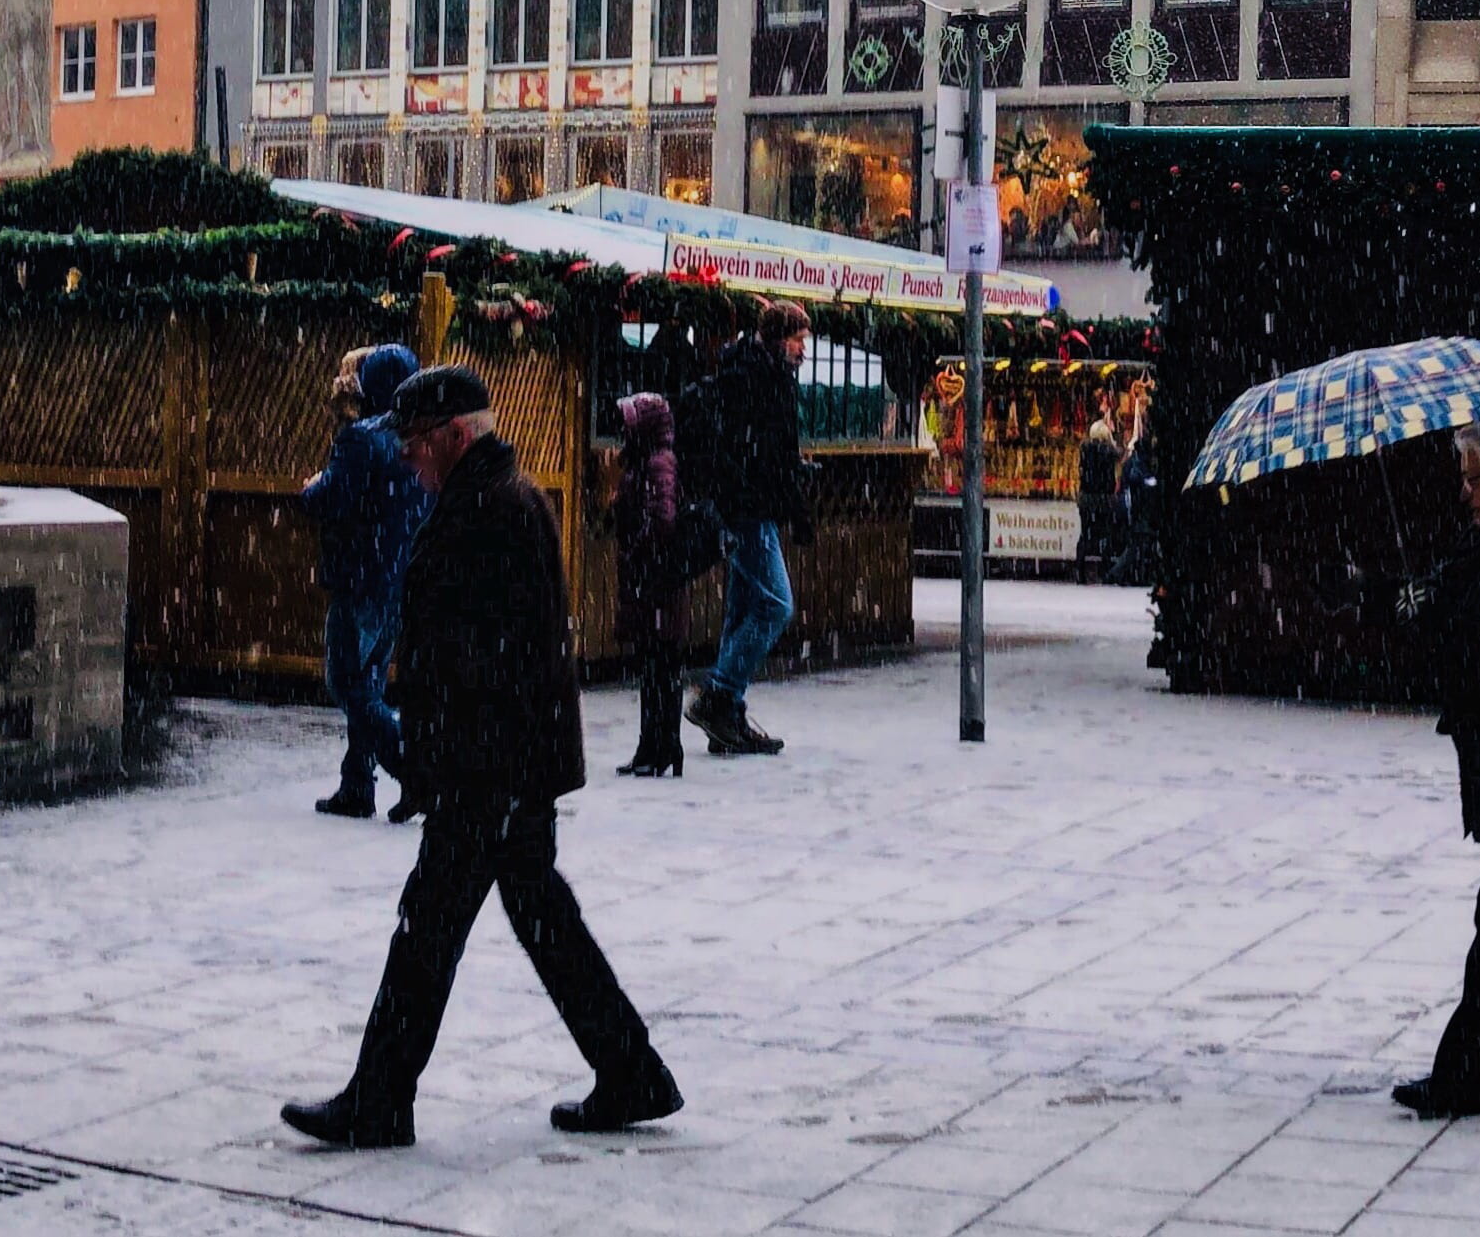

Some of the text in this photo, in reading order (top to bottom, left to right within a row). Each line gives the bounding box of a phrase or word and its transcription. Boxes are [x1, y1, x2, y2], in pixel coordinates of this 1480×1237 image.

[673, 243, 750, 278] Glühwein
[754, 256, 789, 281] nach
[841, 265, 885, 298] Rezept
[901, 271, 943, 299] Punsch
